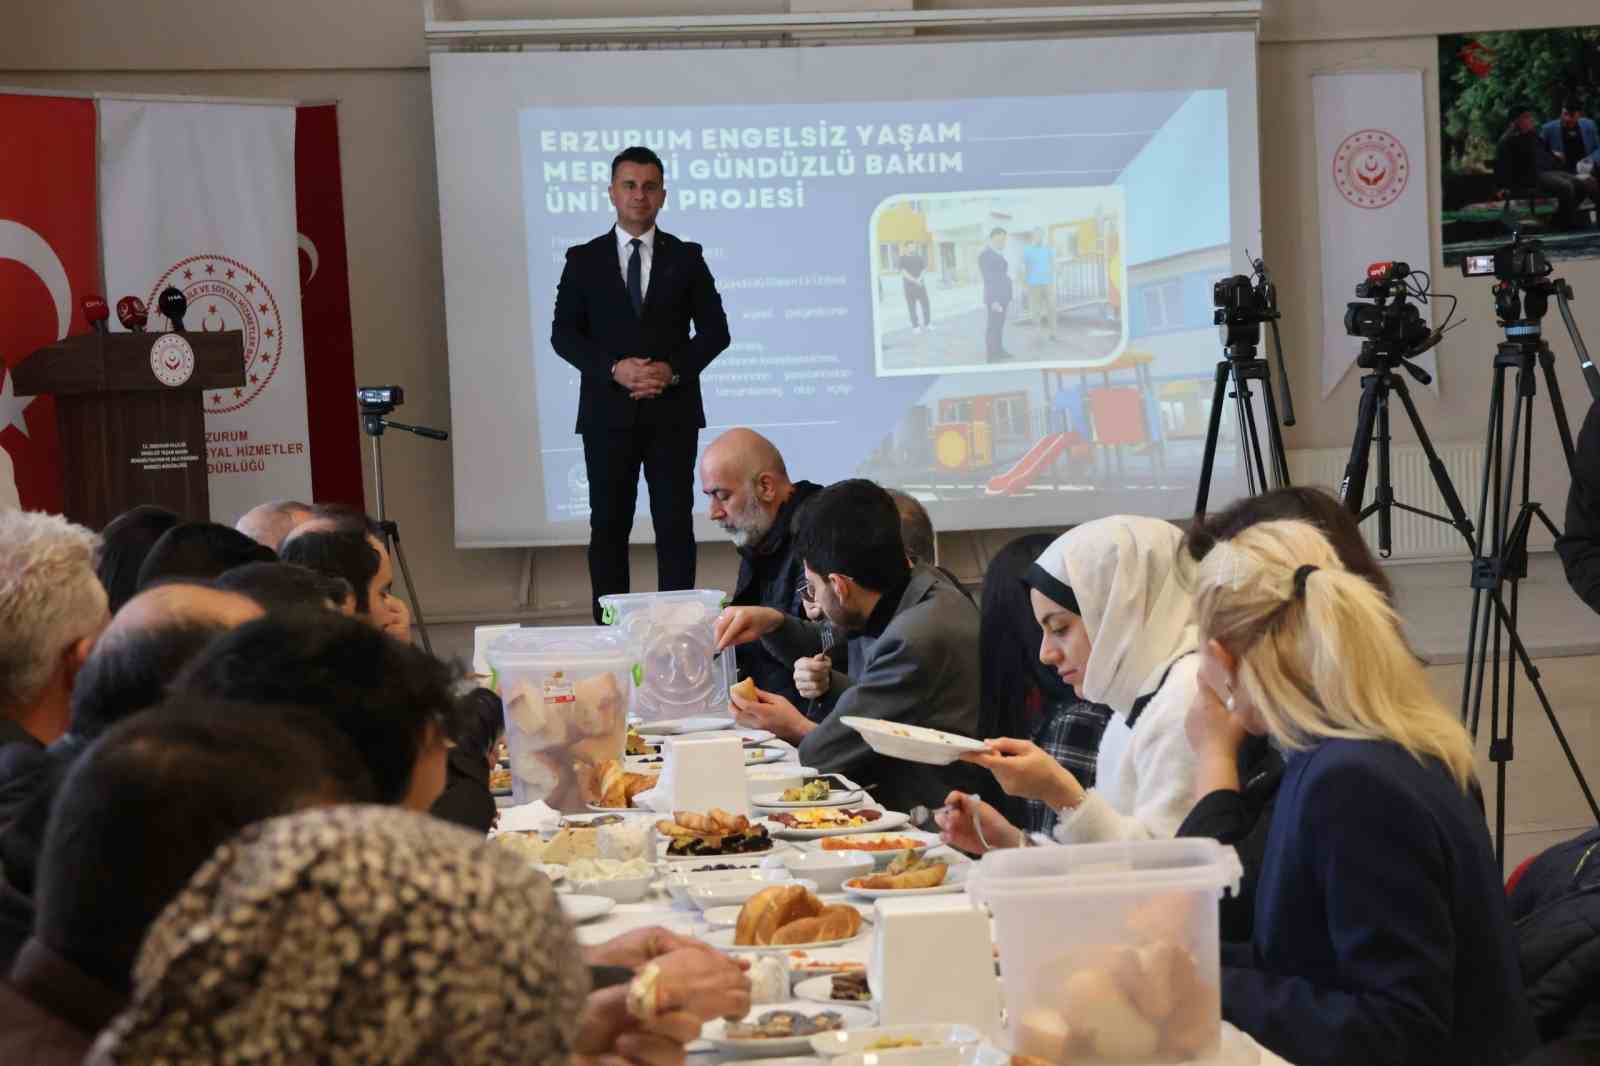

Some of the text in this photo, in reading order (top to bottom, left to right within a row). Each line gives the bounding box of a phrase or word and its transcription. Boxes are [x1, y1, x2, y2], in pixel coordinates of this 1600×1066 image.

[541, 120, 961, 152] ERZURUM ENGELSİZ YAŞAM
[689, 149, 855, 179] GÜNDÜZLÜ
[865, 152, 963, 175] BAKIM
[680, 180, 804, 210] PROJESİ
[207, 431, 248, 442] ZURUM
[208, 443, 304, 458] YAL HİZMETLER
[207, 458, 265, 474] DÜRLÜĞÜ
